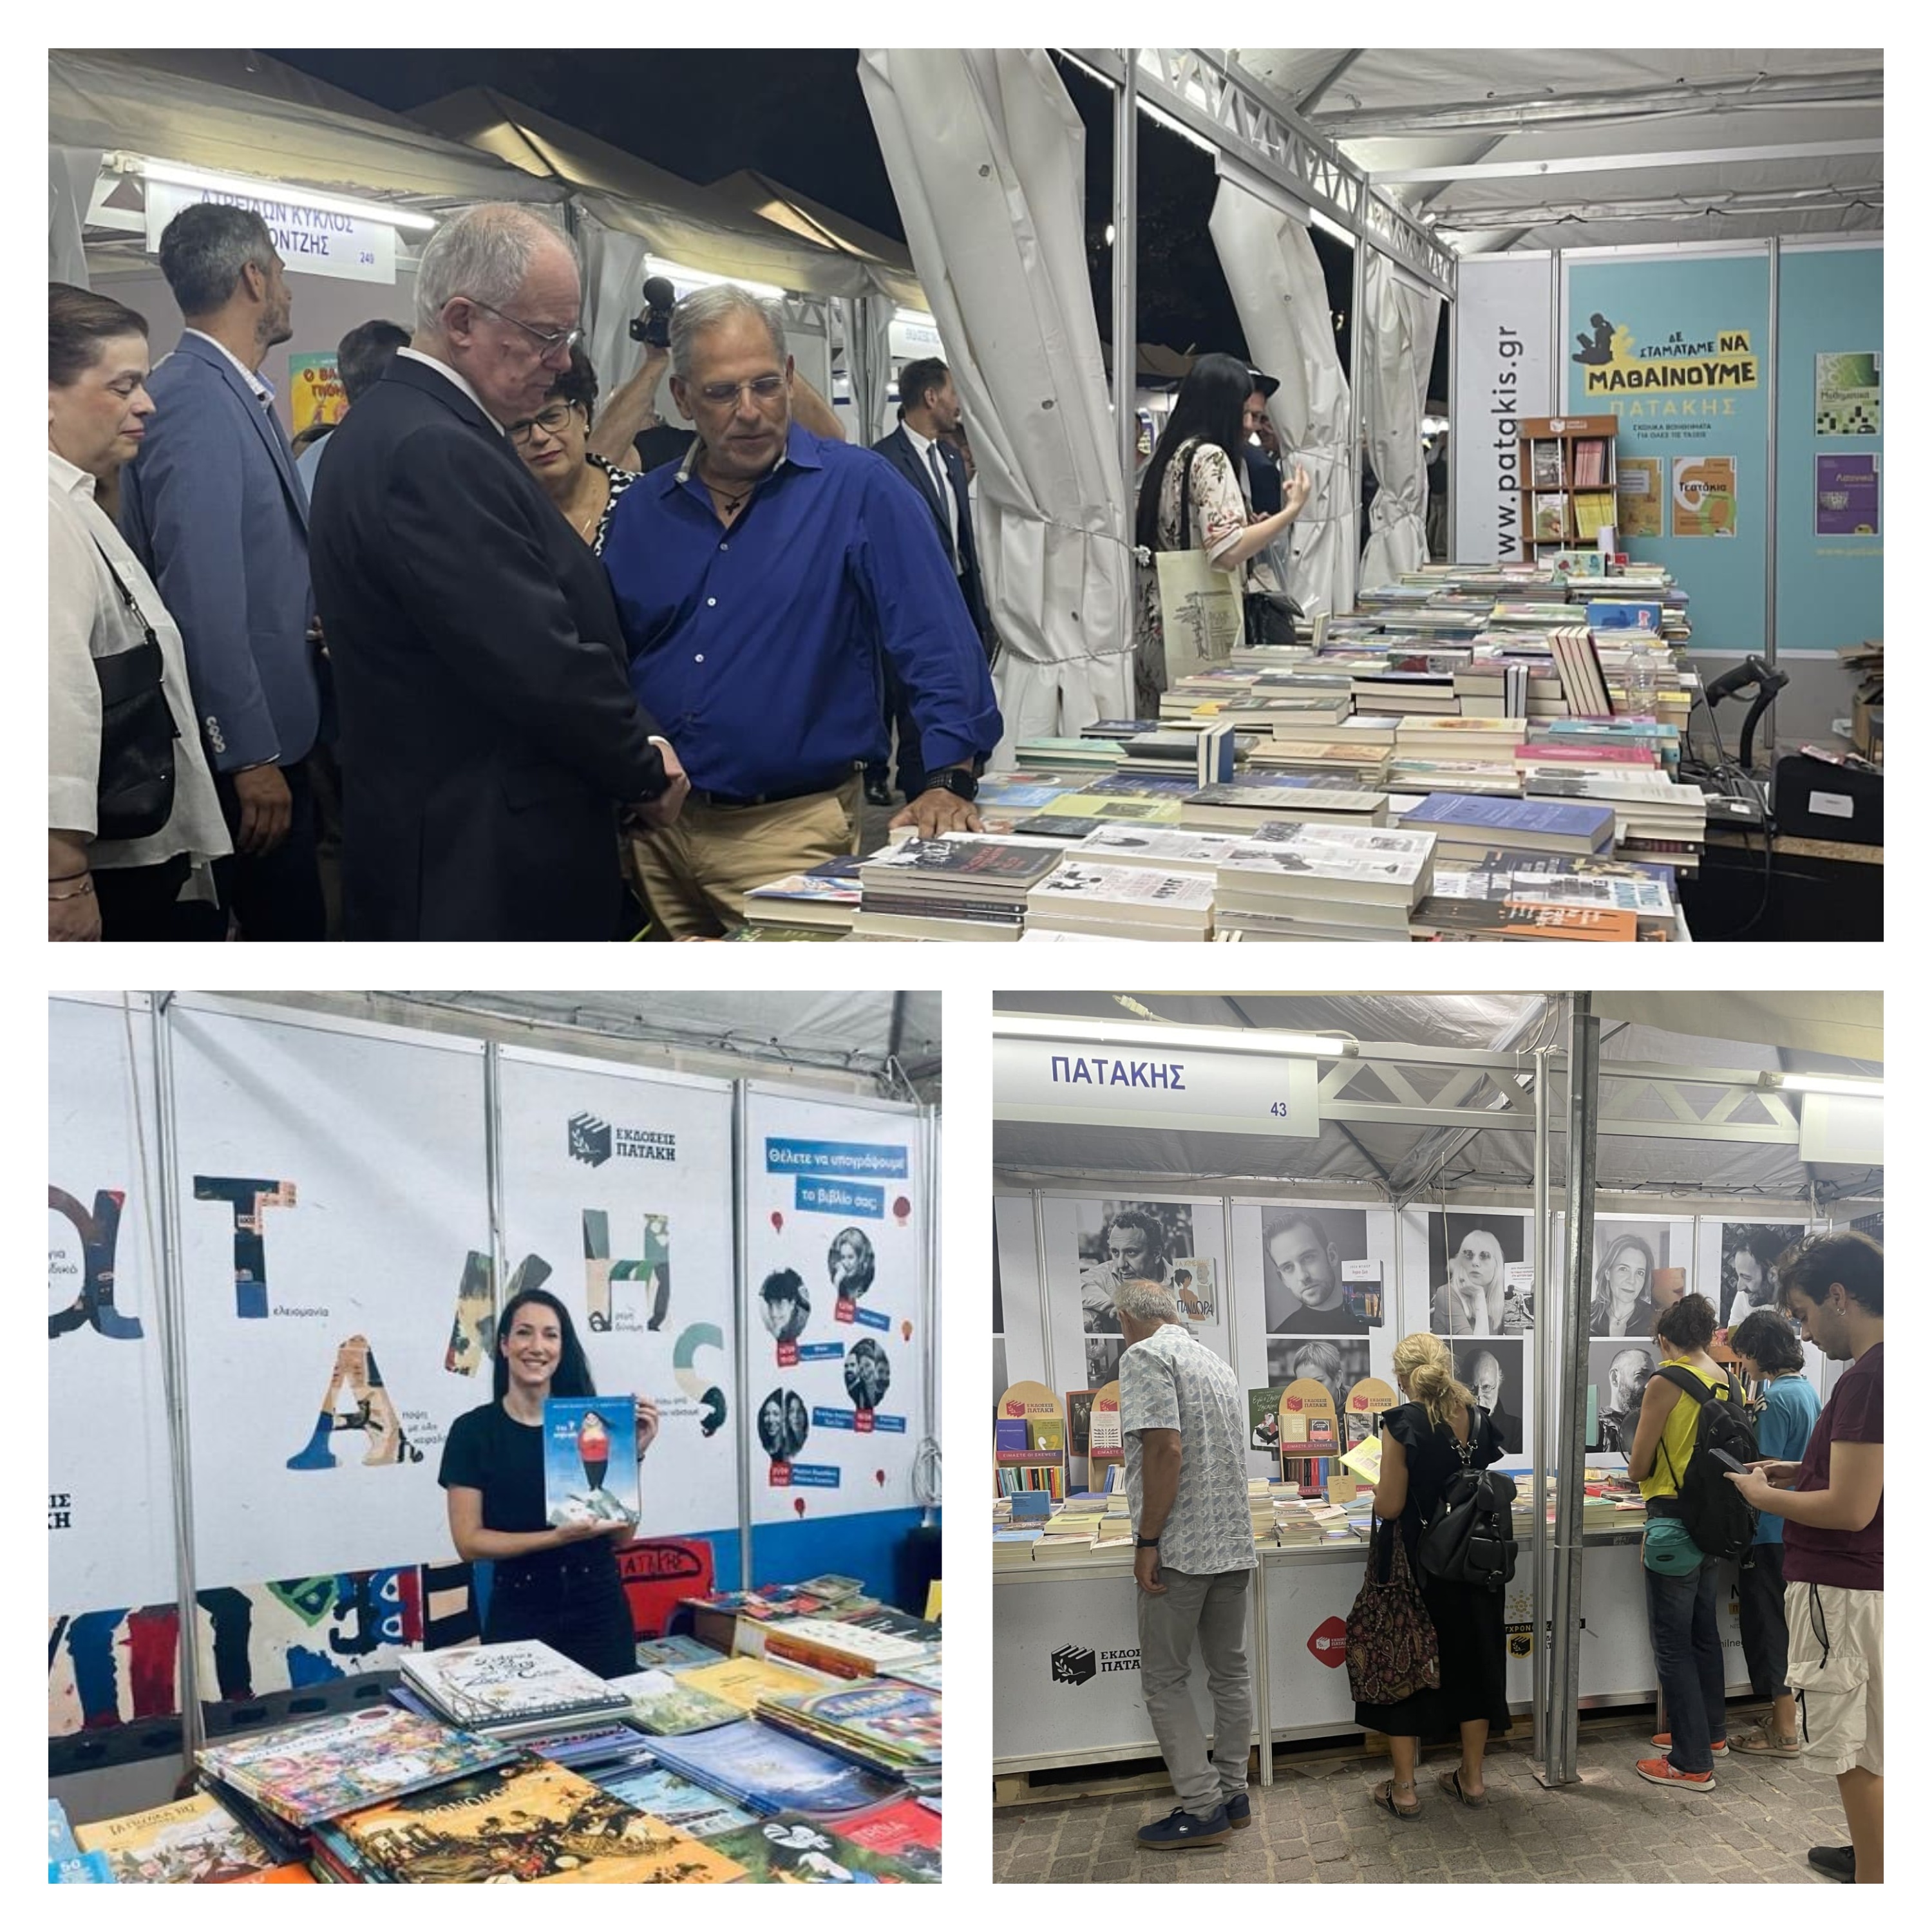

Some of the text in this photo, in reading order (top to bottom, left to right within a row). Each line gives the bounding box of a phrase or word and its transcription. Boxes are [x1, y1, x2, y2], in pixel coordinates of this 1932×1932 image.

[292, 205, 354, 233] ΚΥΚΛΟΣ
[1669, 331, 1683, 343] ΔΕ
[1640, 335, 1749, 358] ΣΤΑΜΑΤΑΜΕ ΝΑ
[1589, 362, 1756, 391] ΜΑΘΑΙΝΟΥΜΕ
[1611, 399, 1736, 417] ΠΑΤΑΚΗΣ
[1491, 326, 1524, 562] ww.patakis.gr
[1052, 1056, 1186, 1090] ΠΑΤΑΚΗΣ
[1270, 1102, 1287, 1117] 43
[616, 1128, 676, 1145] ΕΚΔΟΣΕΙΣ
[616, 1142, 676, 1161] ΠΑΤΑΚΗ
[769, 1148, 811, 1164] Θέλετε
[1101, 1660, 1141, 1672] ΠΑΤΑ
